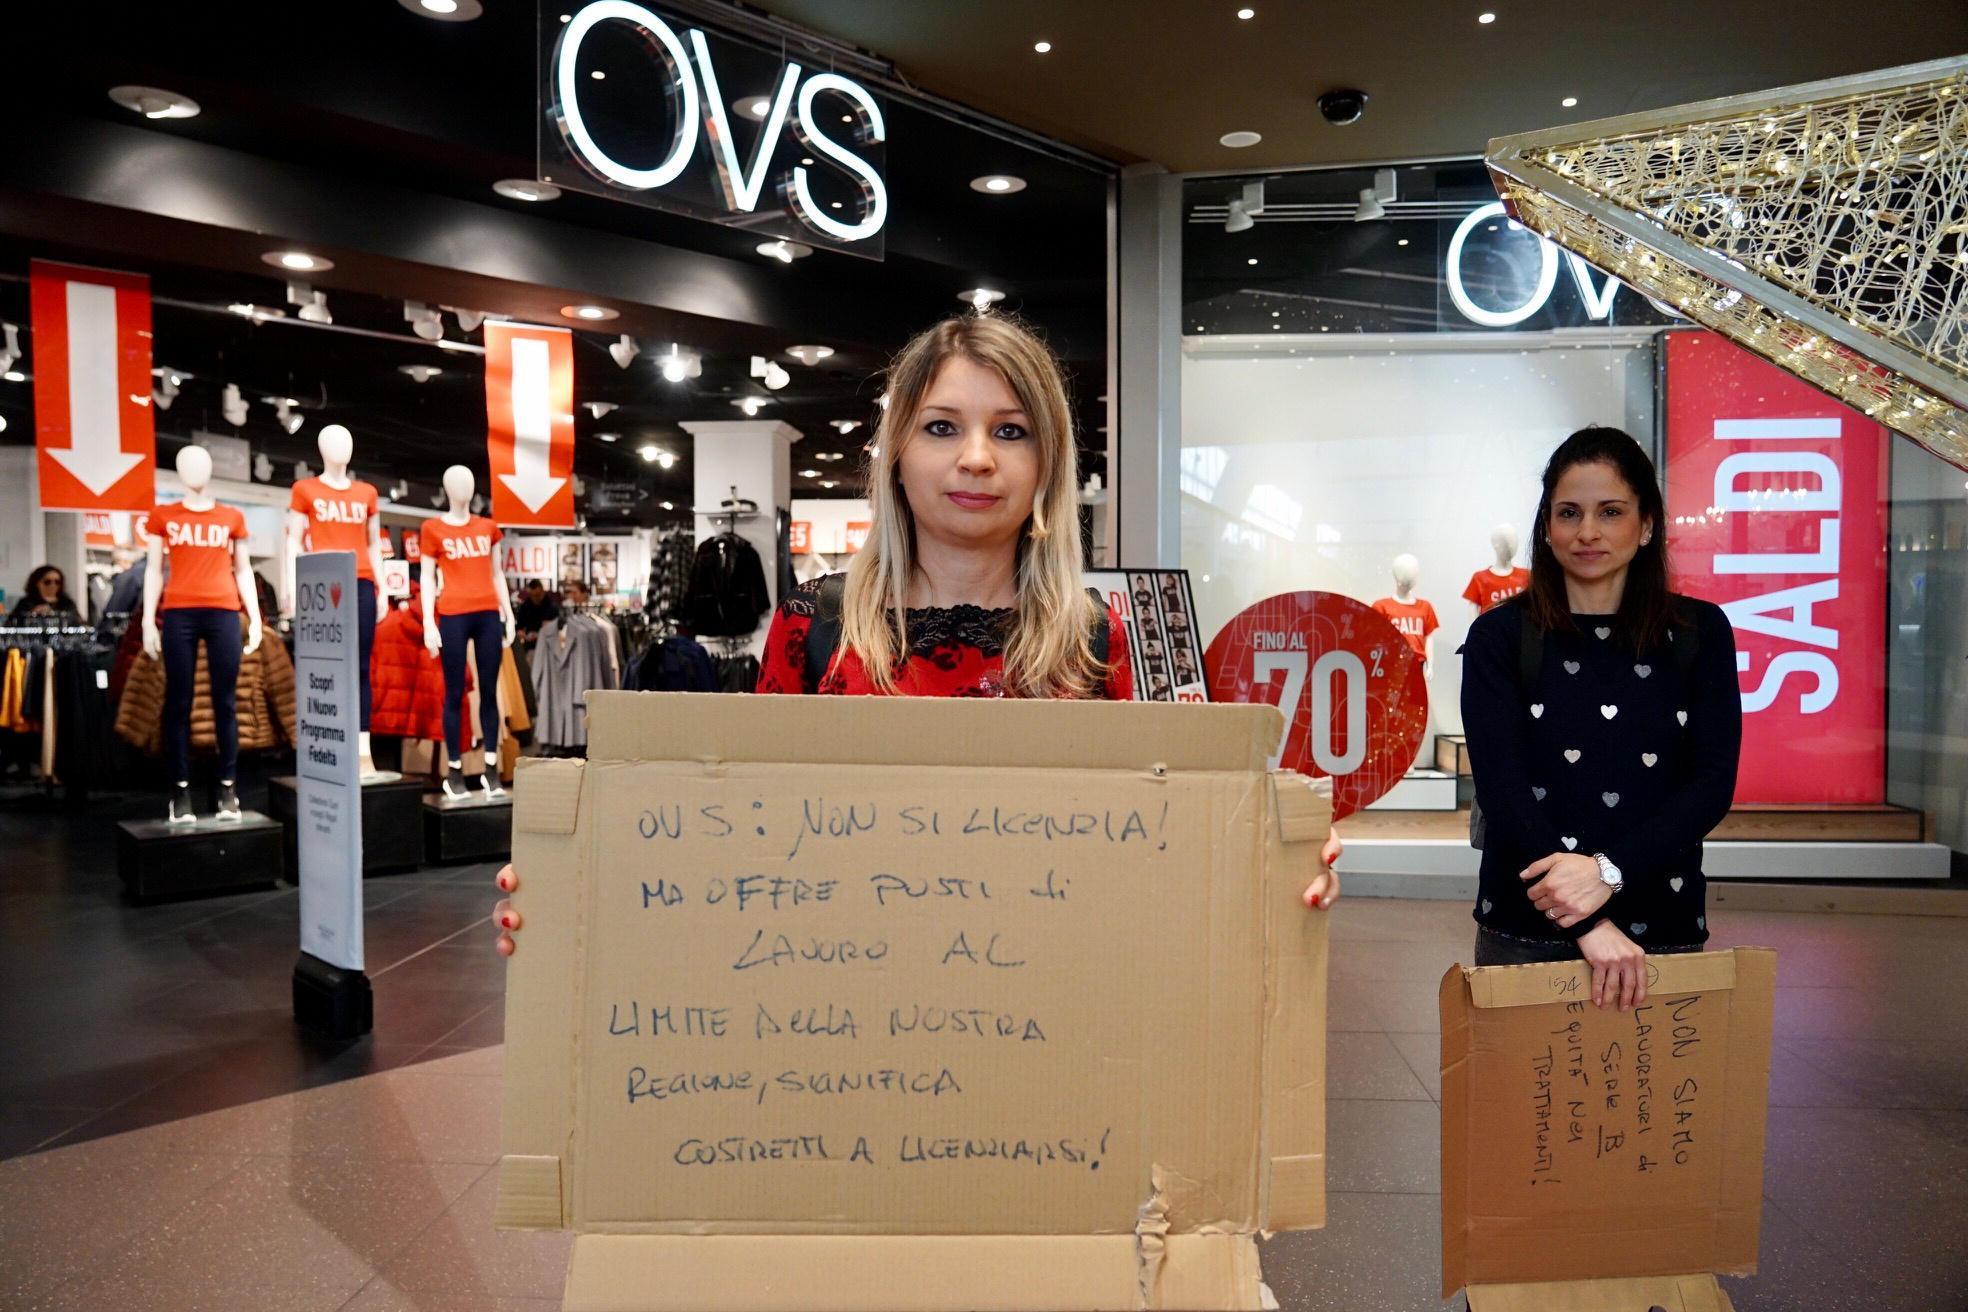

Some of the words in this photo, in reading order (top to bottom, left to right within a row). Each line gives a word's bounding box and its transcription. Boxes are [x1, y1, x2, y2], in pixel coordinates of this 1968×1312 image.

[558, 0, 887, 240] OVS
[501, 547, 552, 573] ALDI
[1713, 418, 1841, 714] SALDI
[300, 582, 326, 611] OVS
[300, 615, 342, 643] Friends
[1254, 632, 1286, 649] FINO
[1290, 632, 1307, 649] AL
[309, 672, 335, 694] Scopri
[300, 719, 345, 743] Programma
[788, 797, 876, 861] NON
[642, 878, 684, 909] MA
[609, 1001, 730, 1037] LIMITE
[1665, 995, 1702, 1058] NON
[1673, 1078, 1698, 1165] SIAMO
